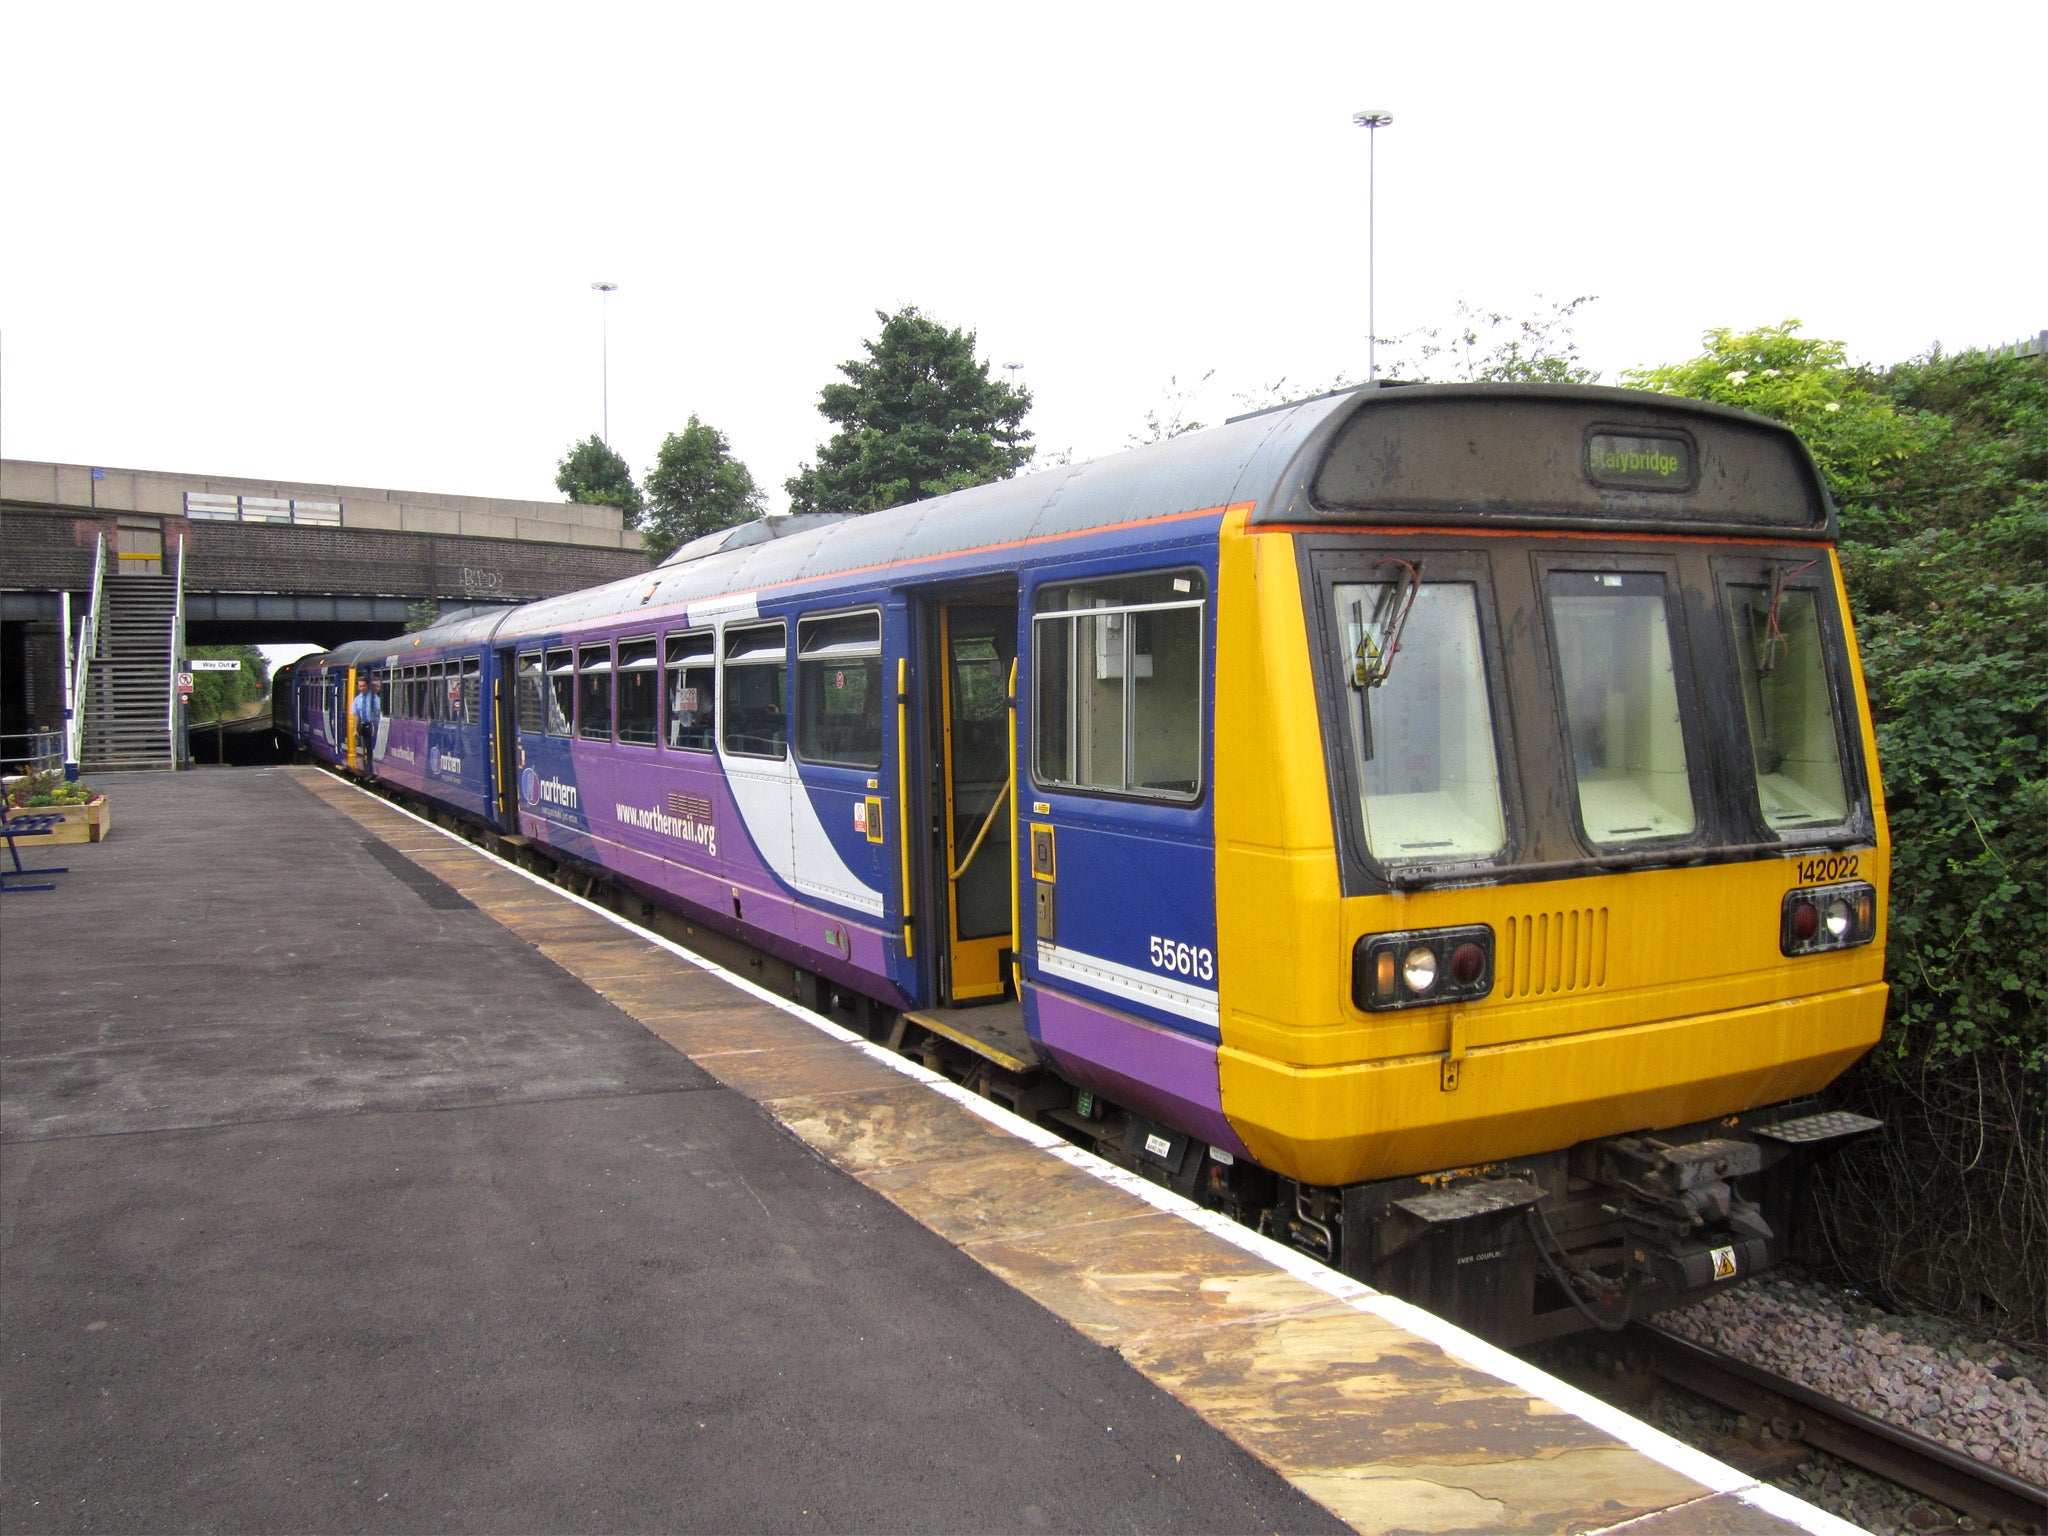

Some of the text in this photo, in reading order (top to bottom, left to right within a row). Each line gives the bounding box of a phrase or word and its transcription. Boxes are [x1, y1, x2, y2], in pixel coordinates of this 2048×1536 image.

[540, 775, 577, 809] northern
[615, 802, 717, 857] www.northernrail.org
[1796, 854, 1859, 885] 142022
[1150, 935, 1214, 981] 55613
